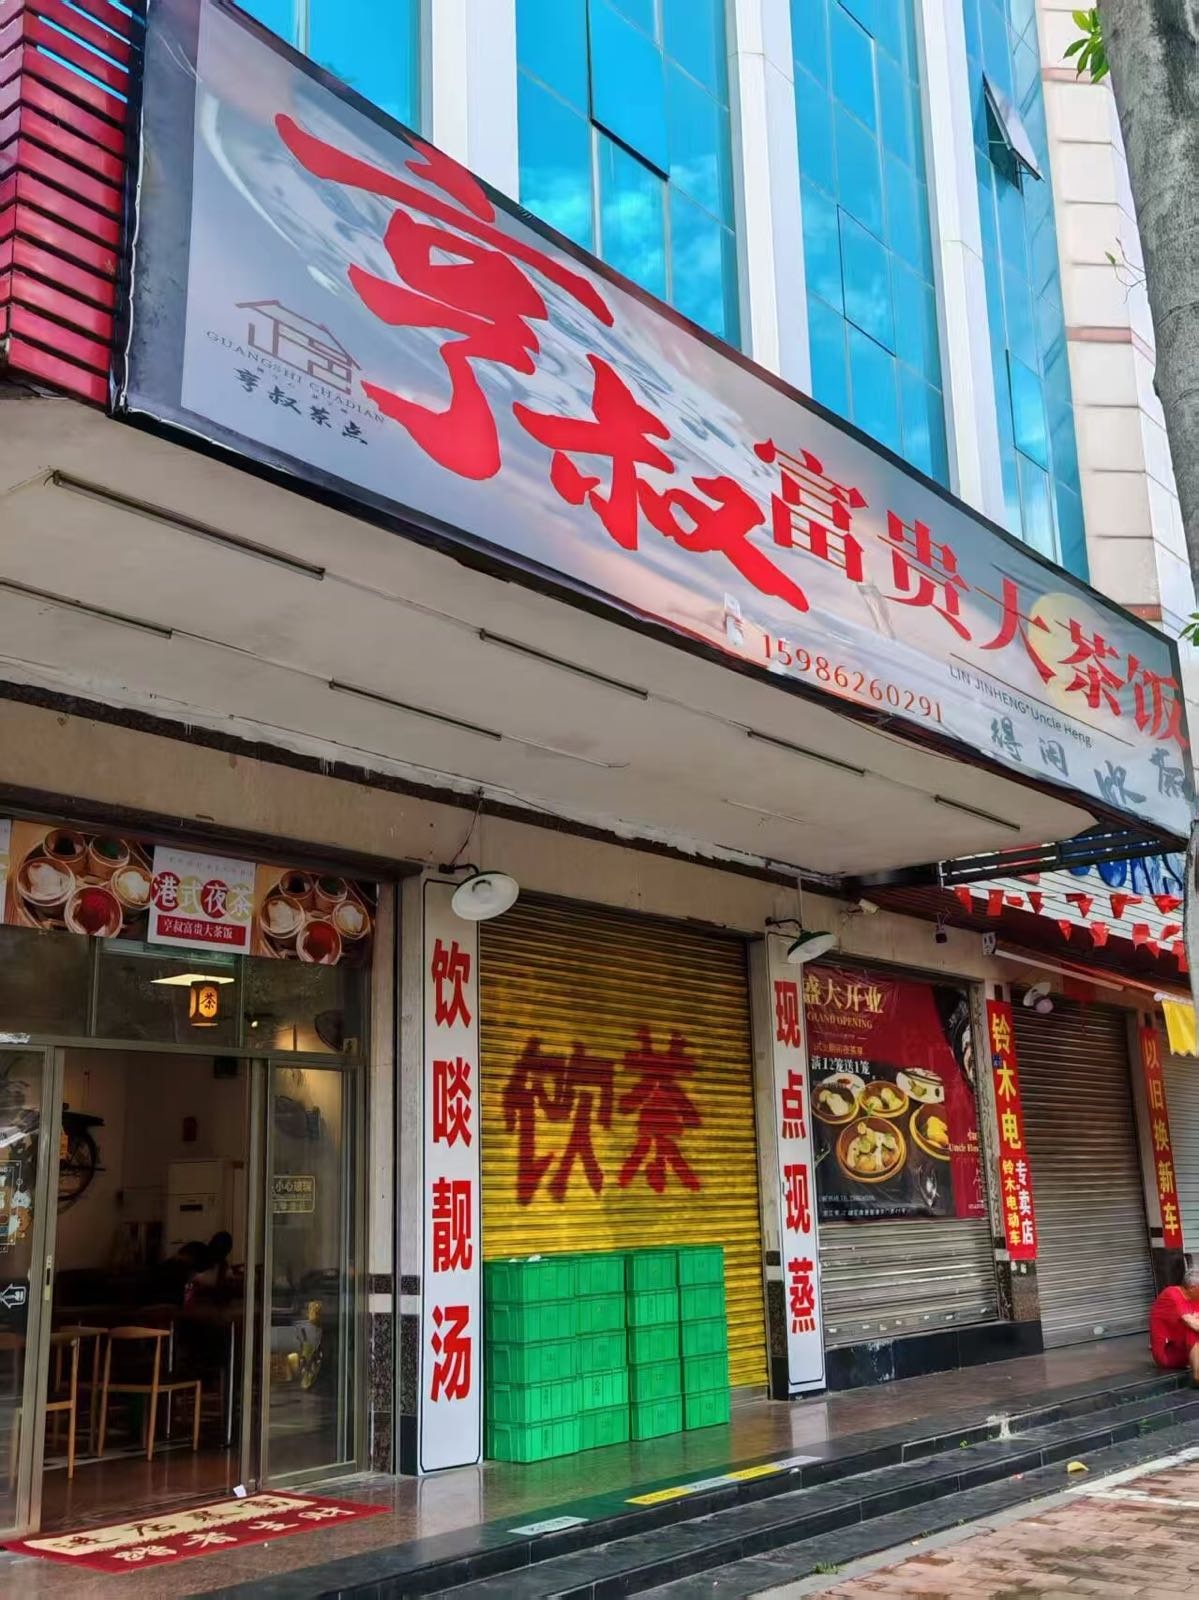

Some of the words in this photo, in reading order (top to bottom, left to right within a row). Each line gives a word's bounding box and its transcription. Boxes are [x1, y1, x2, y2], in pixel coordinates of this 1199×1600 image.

[233, 366, 369, 446] 亨叔茶点
[763, 634, 943, 723] 15986260291
[948, 665, 972, 685] LIN
[1063, 724, 1093, 747] Heng
[151, 872, 254, 917] 港式夜茶
[200, 991, 217, 1010] 茶
[803, 974, 885, 1014] 盛大开业
[501, 1025, 702, 1207] 饮茶
[992, 1012, 1022, 1149] 铃木电
[430, 937, 474, 1402] 饮啖靓汤
[773, 979, 817, 1334] 现点现蒸
[1144, 1039, 1179, 1236] 以旧换新车
[1002, 1160, 1021, 1246] 铃木电动车
[1015, 1160, 1034, 1245] 专卖店
